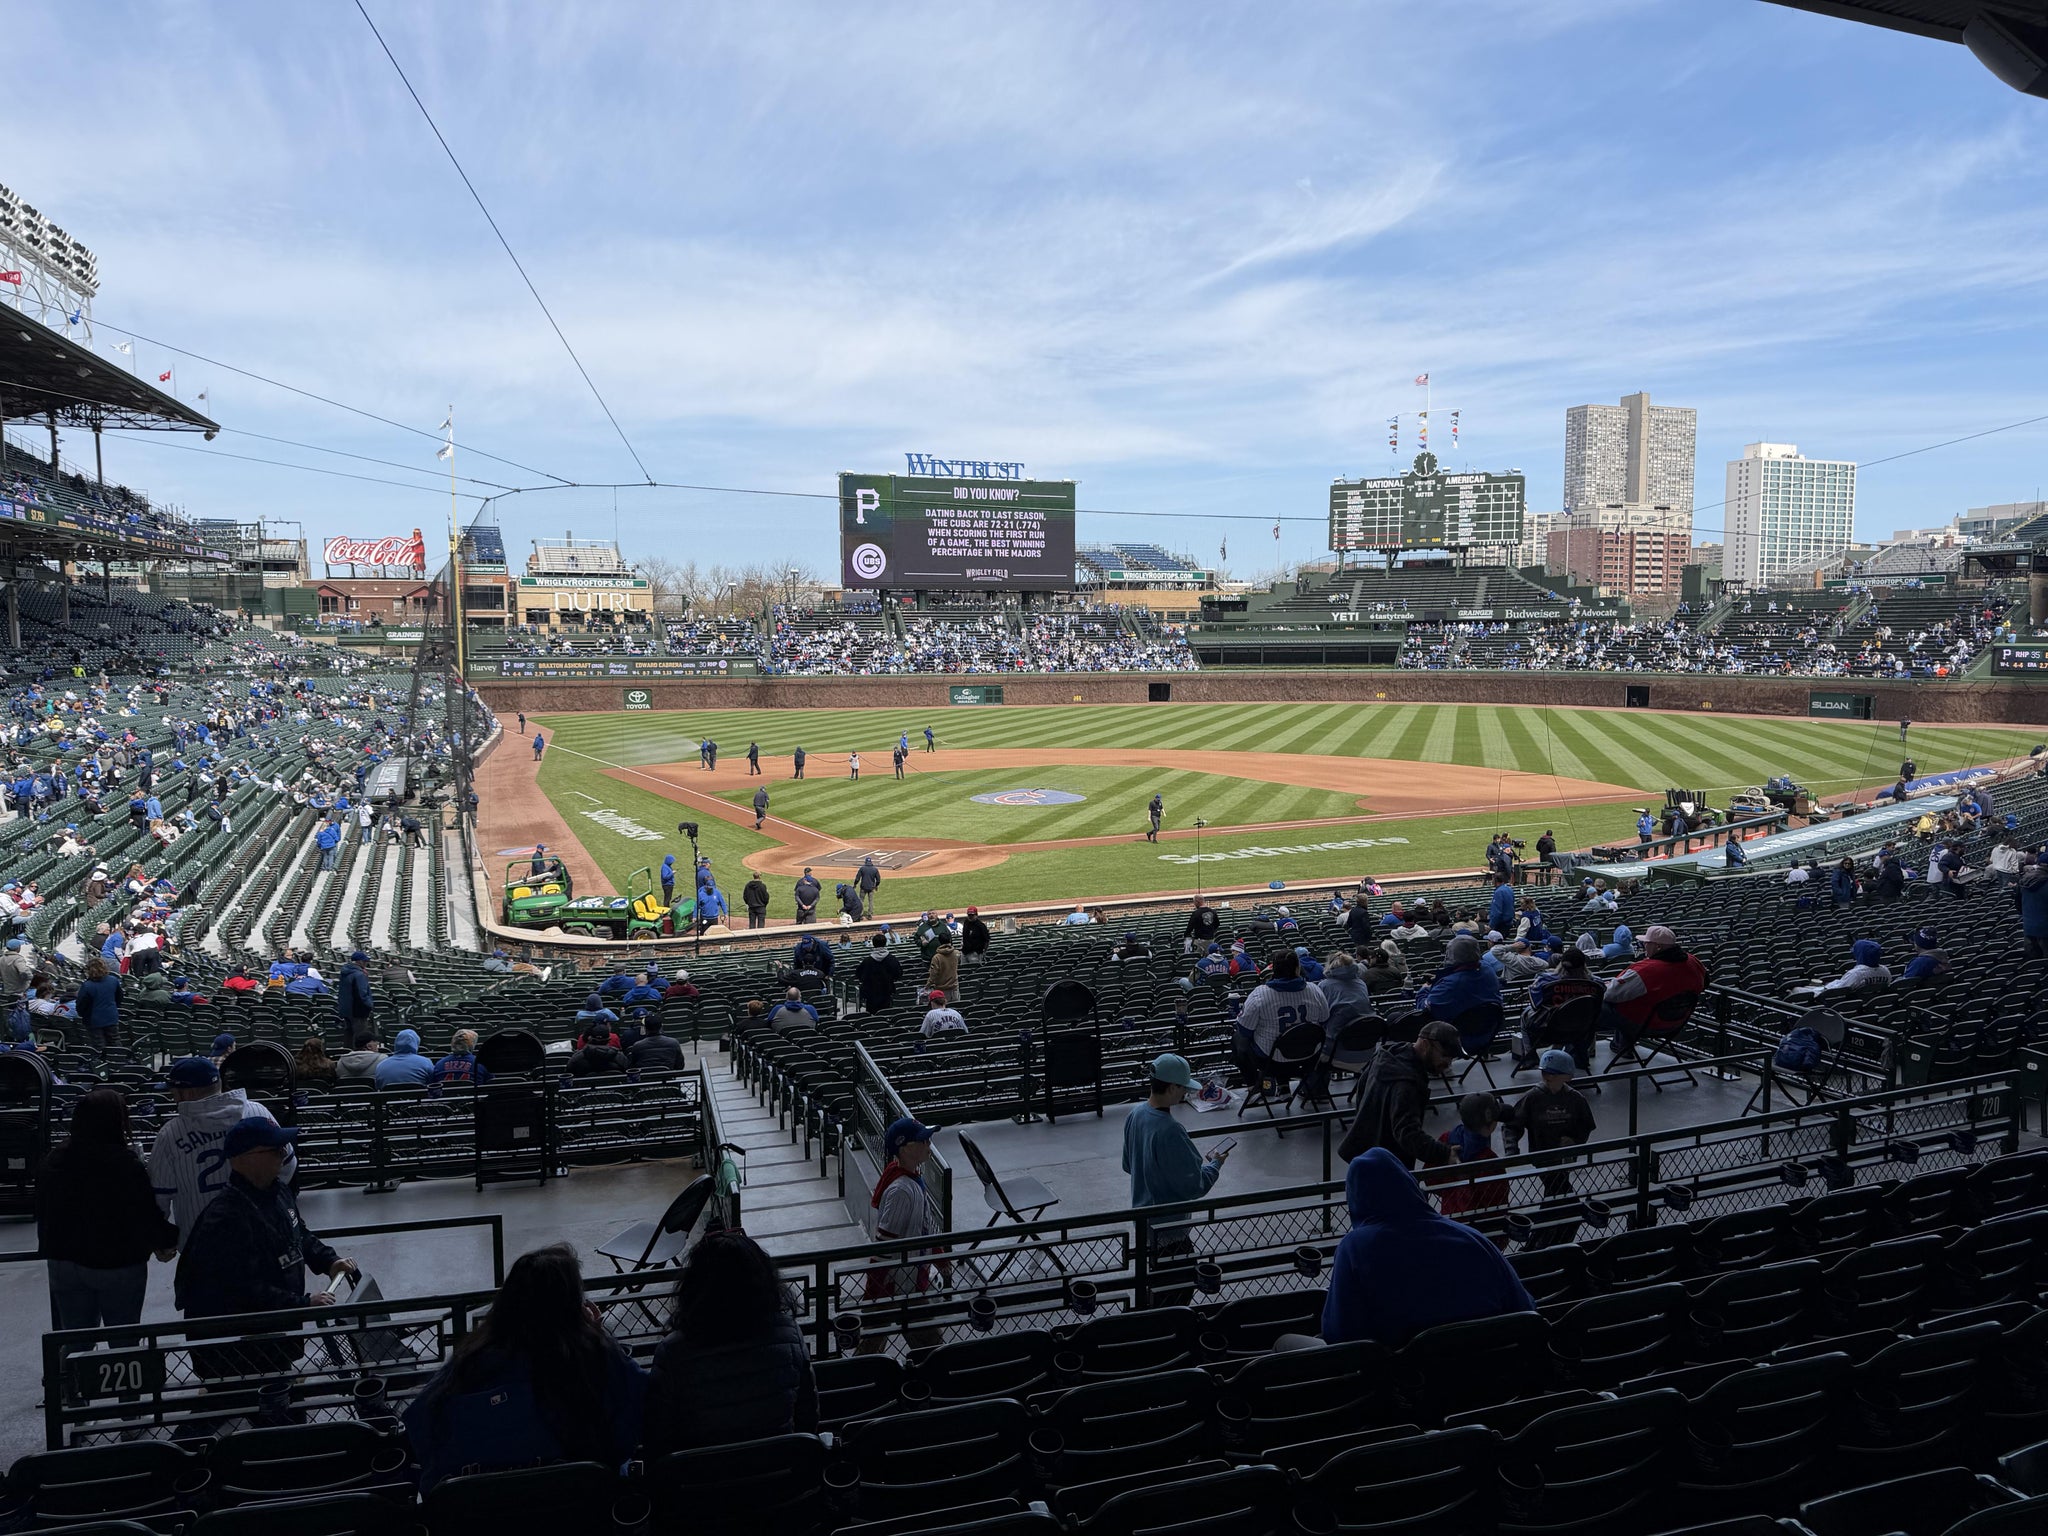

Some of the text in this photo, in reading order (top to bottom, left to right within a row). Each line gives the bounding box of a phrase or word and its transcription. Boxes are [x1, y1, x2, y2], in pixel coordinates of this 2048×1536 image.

[904, 453, 1025, 480] WINTRUST
[1366, 480, 1405, 488] NATIONAL
[1445, 475, 1486, 484] AMERICAN
[954, 486, 1020, 500] DID YOU KNOW?
[926, 508, 1046, 520] DATING BACK TO LAST SEASON,
[932, 519, 1040, 530] THE CUBS ARE 72-21 (.774)
[928, 528, 951, 537] WHEN
[953, 529, 988, 538] SCORING
[990, 530, 1004, 538] THE
[1006, 530, 1028, 538] FIRST
[928, 538, 938, 546] OF
[948, 538, 972, 548] GAME,
[991, 540, 1011, 548] BEST
[1013, 540, 1046, 548] WINNING
[324, 536, 420, 567] Coca-Cola
[932, 548, 1042, 558] PERCENTAGE IN THE MAJORS
[966, 568, 1008, 578] WRIGLEY FIELD
[1331, 612, 1359, 621] YETI
[1376, 612, 1414, 621] tastytrade
[1581, 609, 1618, 617] Advocate
[2031, 651, 2040, 659] 35
[470, 664, 497, 672] Harvey
[1158, 839, 1391, 864] Southwest
[1278, 1004, 1307, 1031] 21
[1851, 1037, 1864, 1048] 120
[1982, 1096, 2000, 1118] 220
[196, 1148, 230, 1194] 2
[100, 1360, 143, 1394] 220
